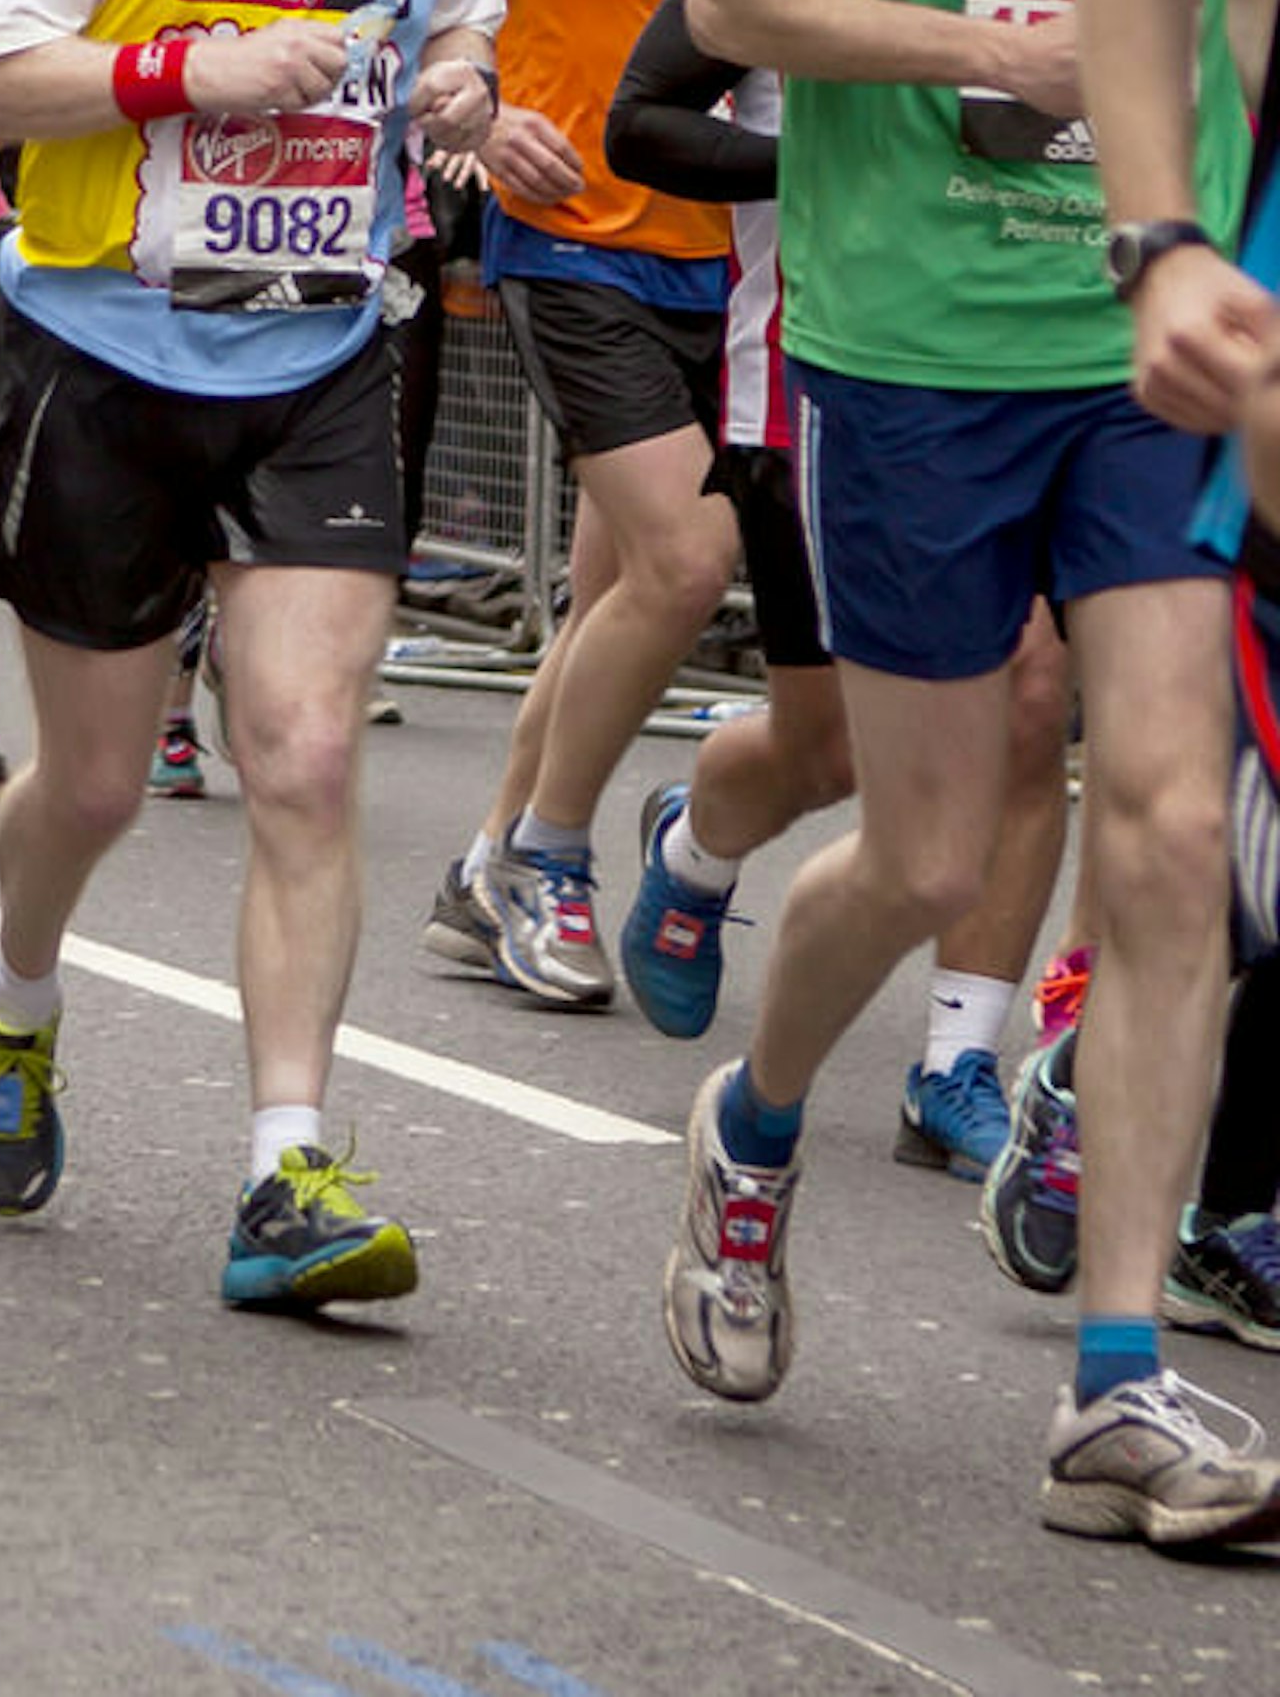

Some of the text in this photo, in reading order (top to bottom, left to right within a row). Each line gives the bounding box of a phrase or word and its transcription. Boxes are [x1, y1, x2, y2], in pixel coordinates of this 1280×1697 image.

[195, 112, 366, 180] Virgin money
[204, 193, 352, 257] 9082
